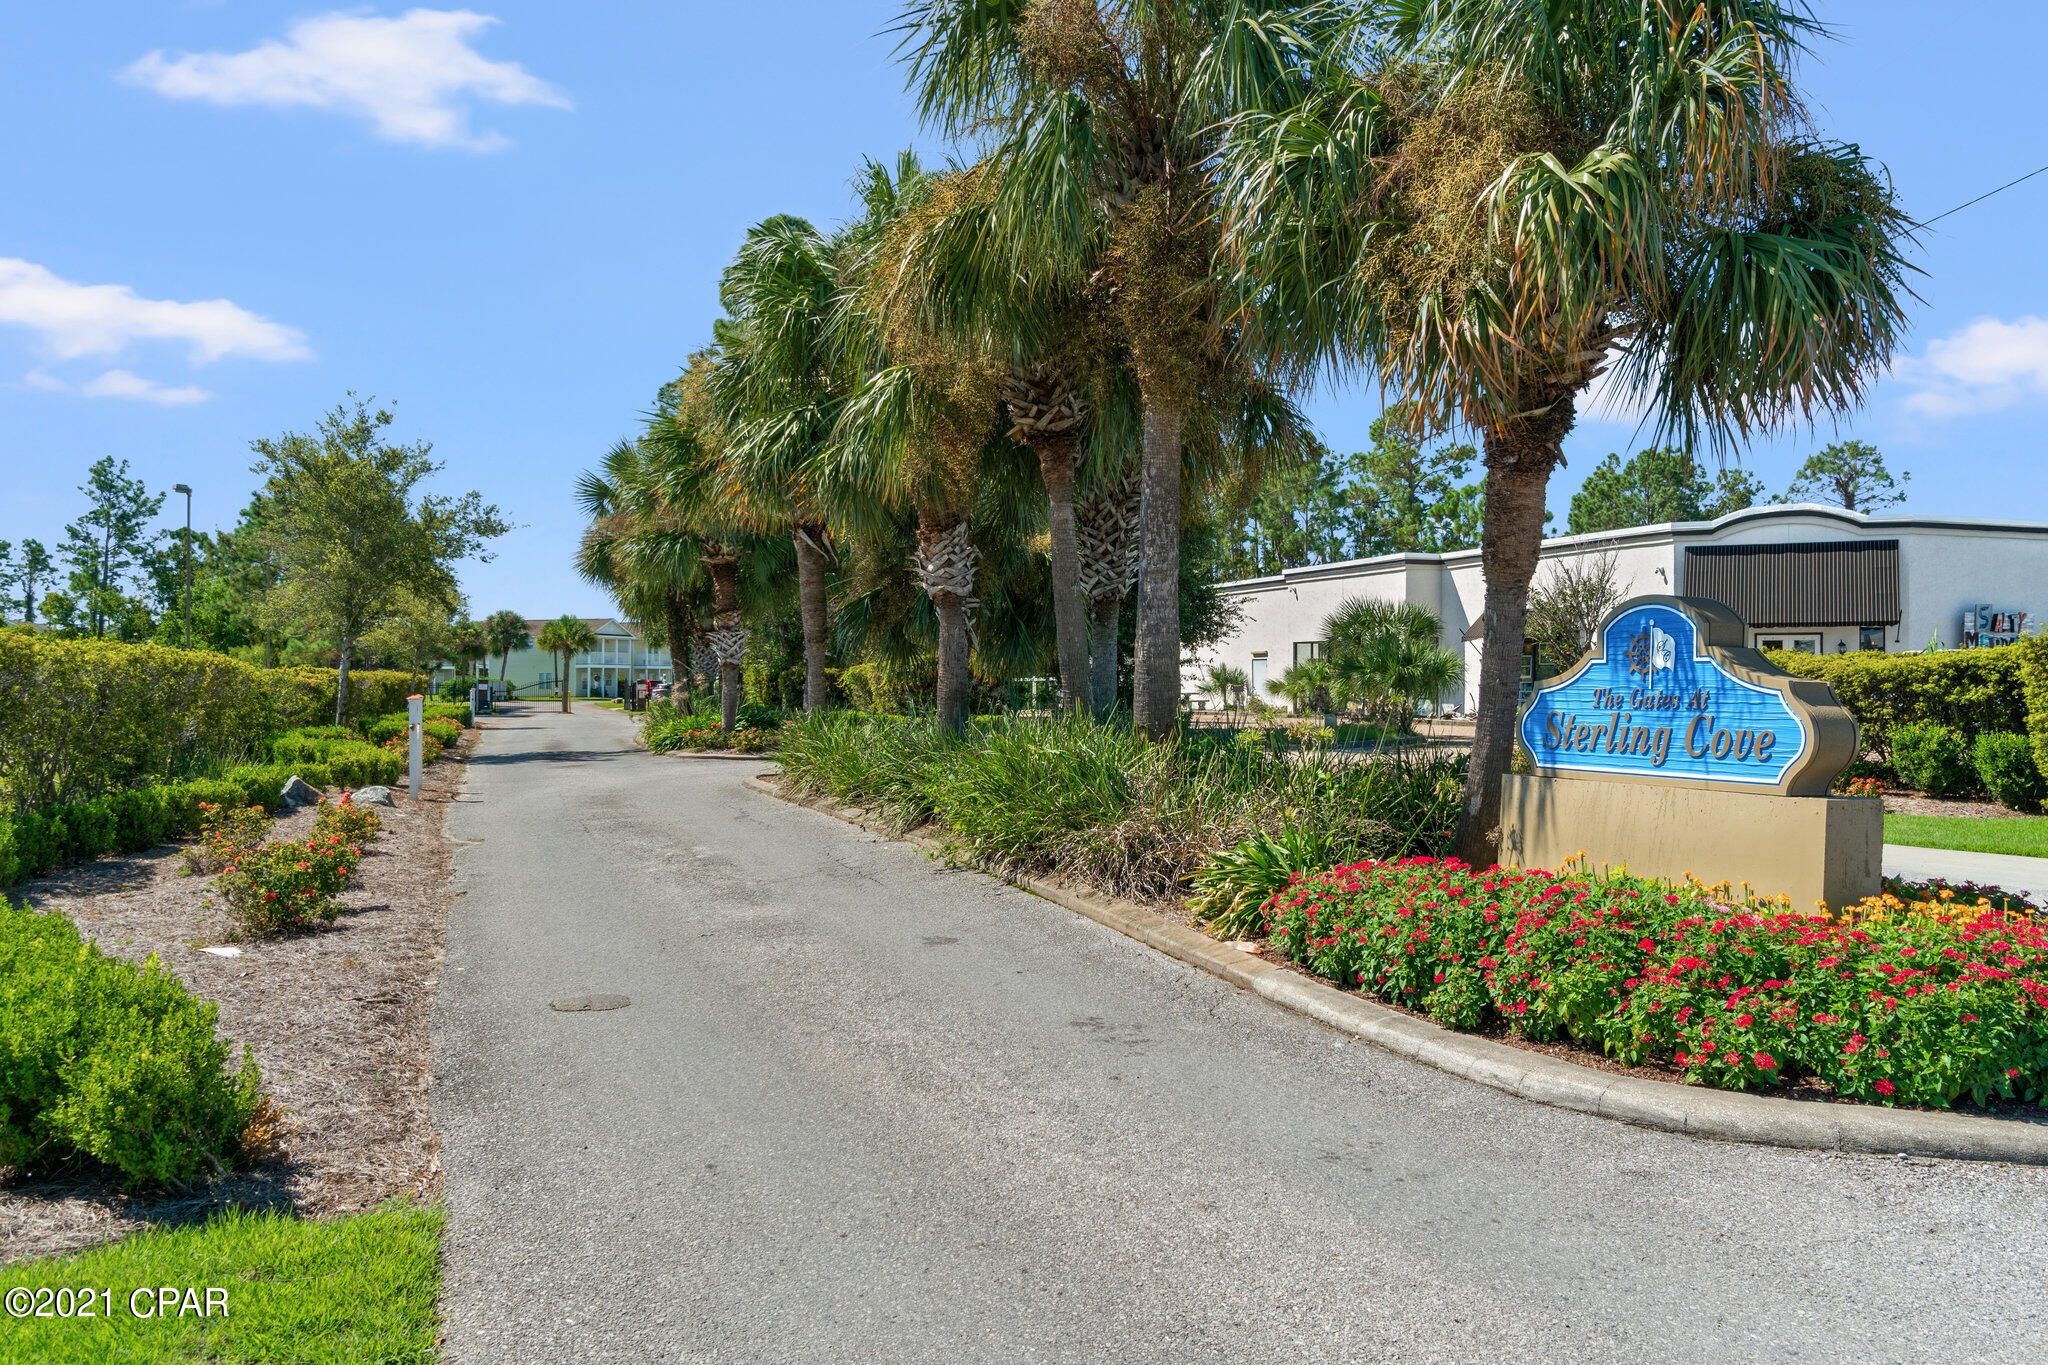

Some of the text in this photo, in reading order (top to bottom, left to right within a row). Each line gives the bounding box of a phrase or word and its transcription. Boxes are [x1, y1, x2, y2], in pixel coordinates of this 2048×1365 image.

[1977, 604, 2028, 633] SALTY
[1593, 687, 1711, 711] The Gates At
[1543, 710, 1777, 767] Sterling Cove
